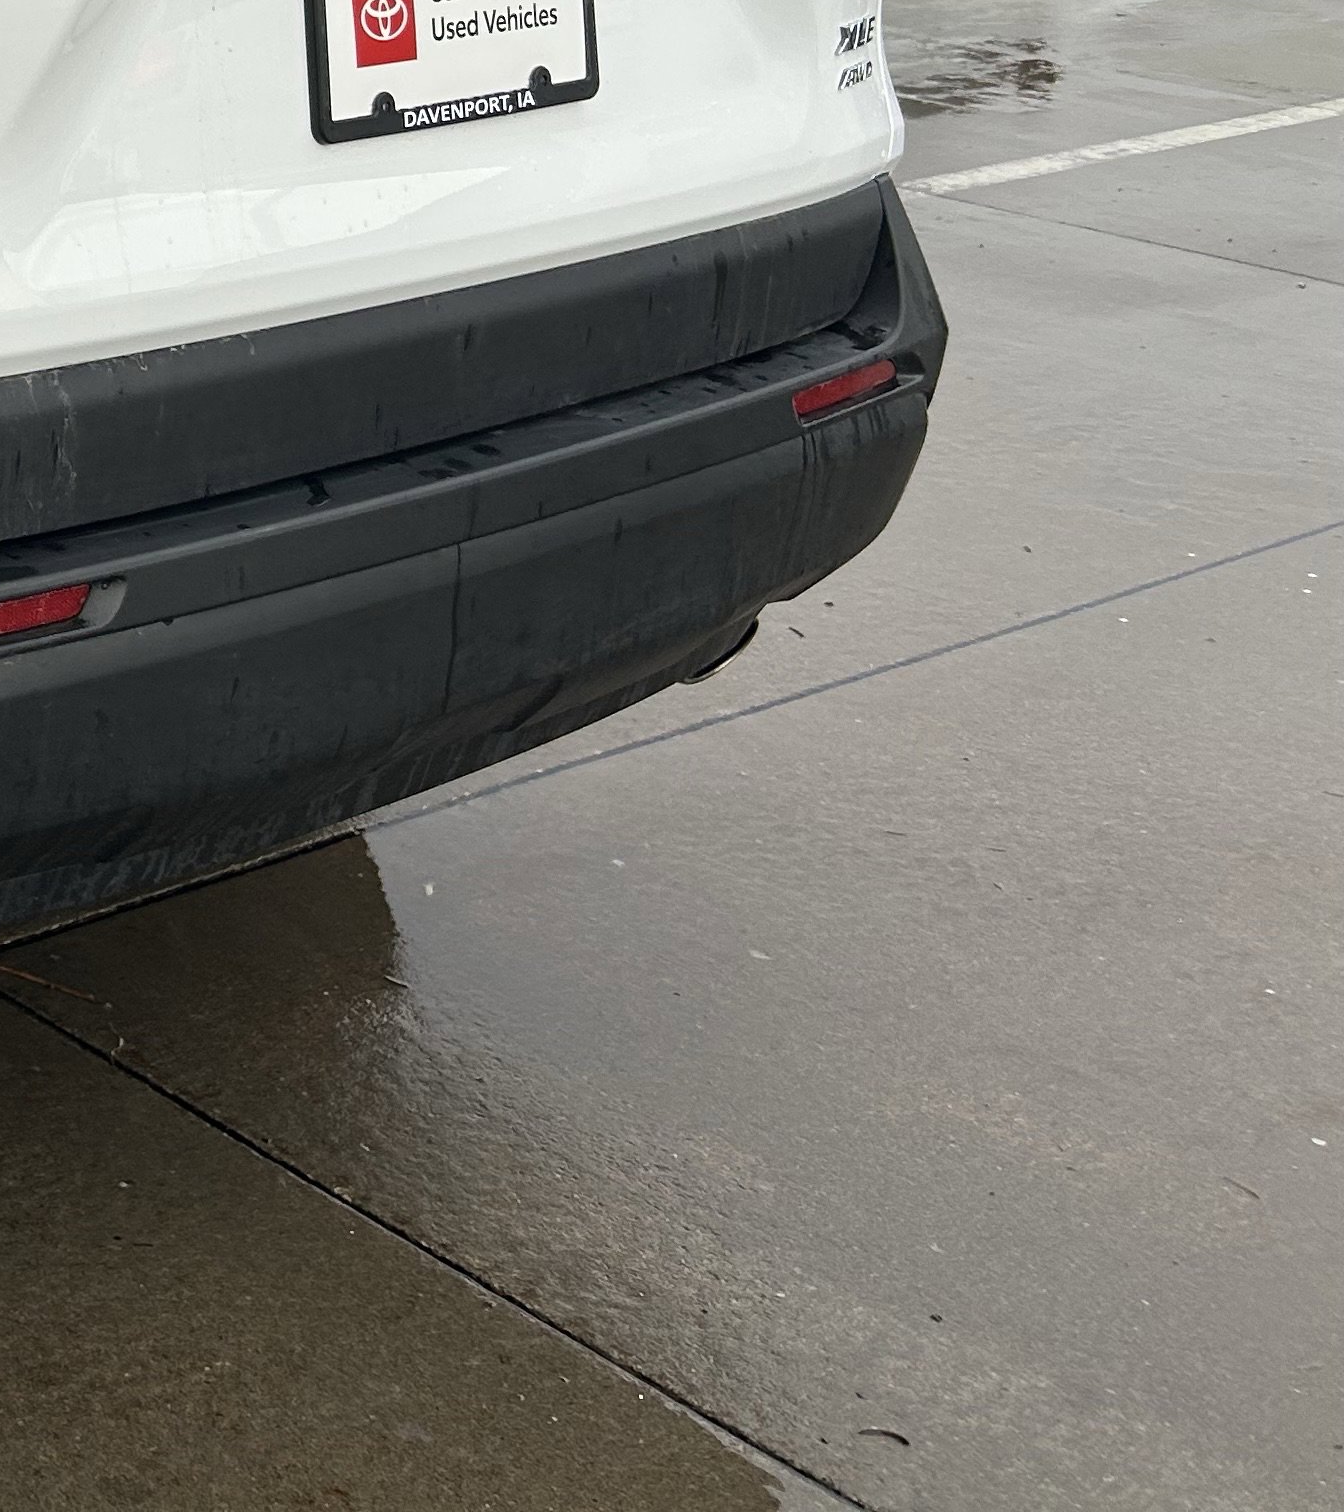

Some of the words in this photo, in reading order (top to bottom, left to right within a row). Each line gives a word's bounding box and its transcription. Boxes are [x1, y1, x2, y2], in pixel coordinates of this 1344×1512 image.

[431, 10, 479, 41] Used
[483, 4, 558, 36] Vehicles
[834, 15, 876, 56] XLE
[837, 60, 873, 91] AWD
[403, 94, 514, 128] DAVENPORT,
[517, 90, 536, 109] IA
